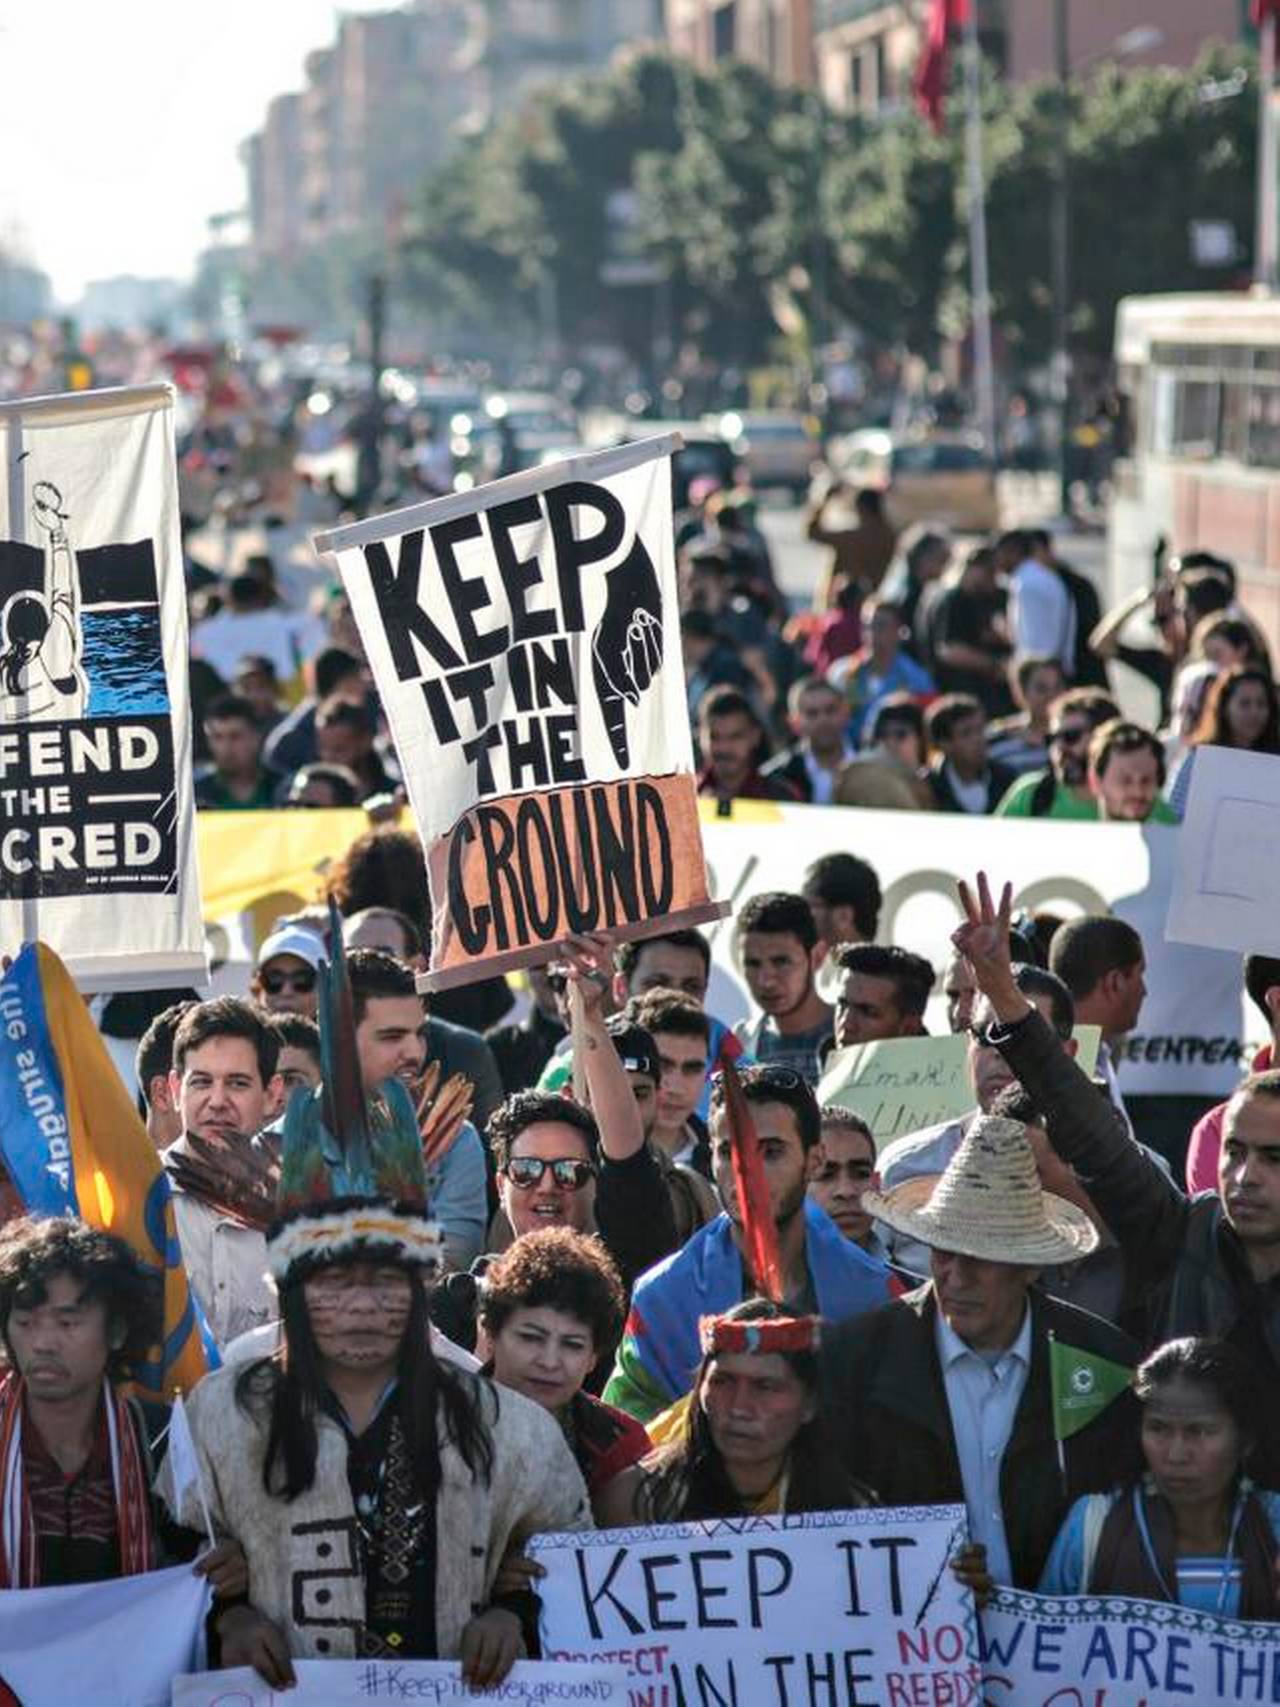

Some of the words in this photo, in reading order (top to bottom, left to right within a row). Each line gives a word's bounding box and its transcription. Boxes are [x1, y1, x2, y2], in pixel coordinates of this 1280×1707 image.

[363, 482, 625, 683] KEEP
[421, 663, 495, 746] IT
[507, 638, 578, 713] IN
[1, 785, 72, 817] THE
[462, 714, 588, 796] THE
[448, 782, 673, 956] GROUND
[575, 1547, 793, 1640] KEEP
[835, 1537, 918, 1617] IT
[763, 1649, 878, 1707] THE
[897, 1625, 963, 1665] NO
[976, 1612, 1067, 1673] WE
[1081, 1625, 1195, 1694] ARE
[1209, 1642, 1280, 1704] TH
